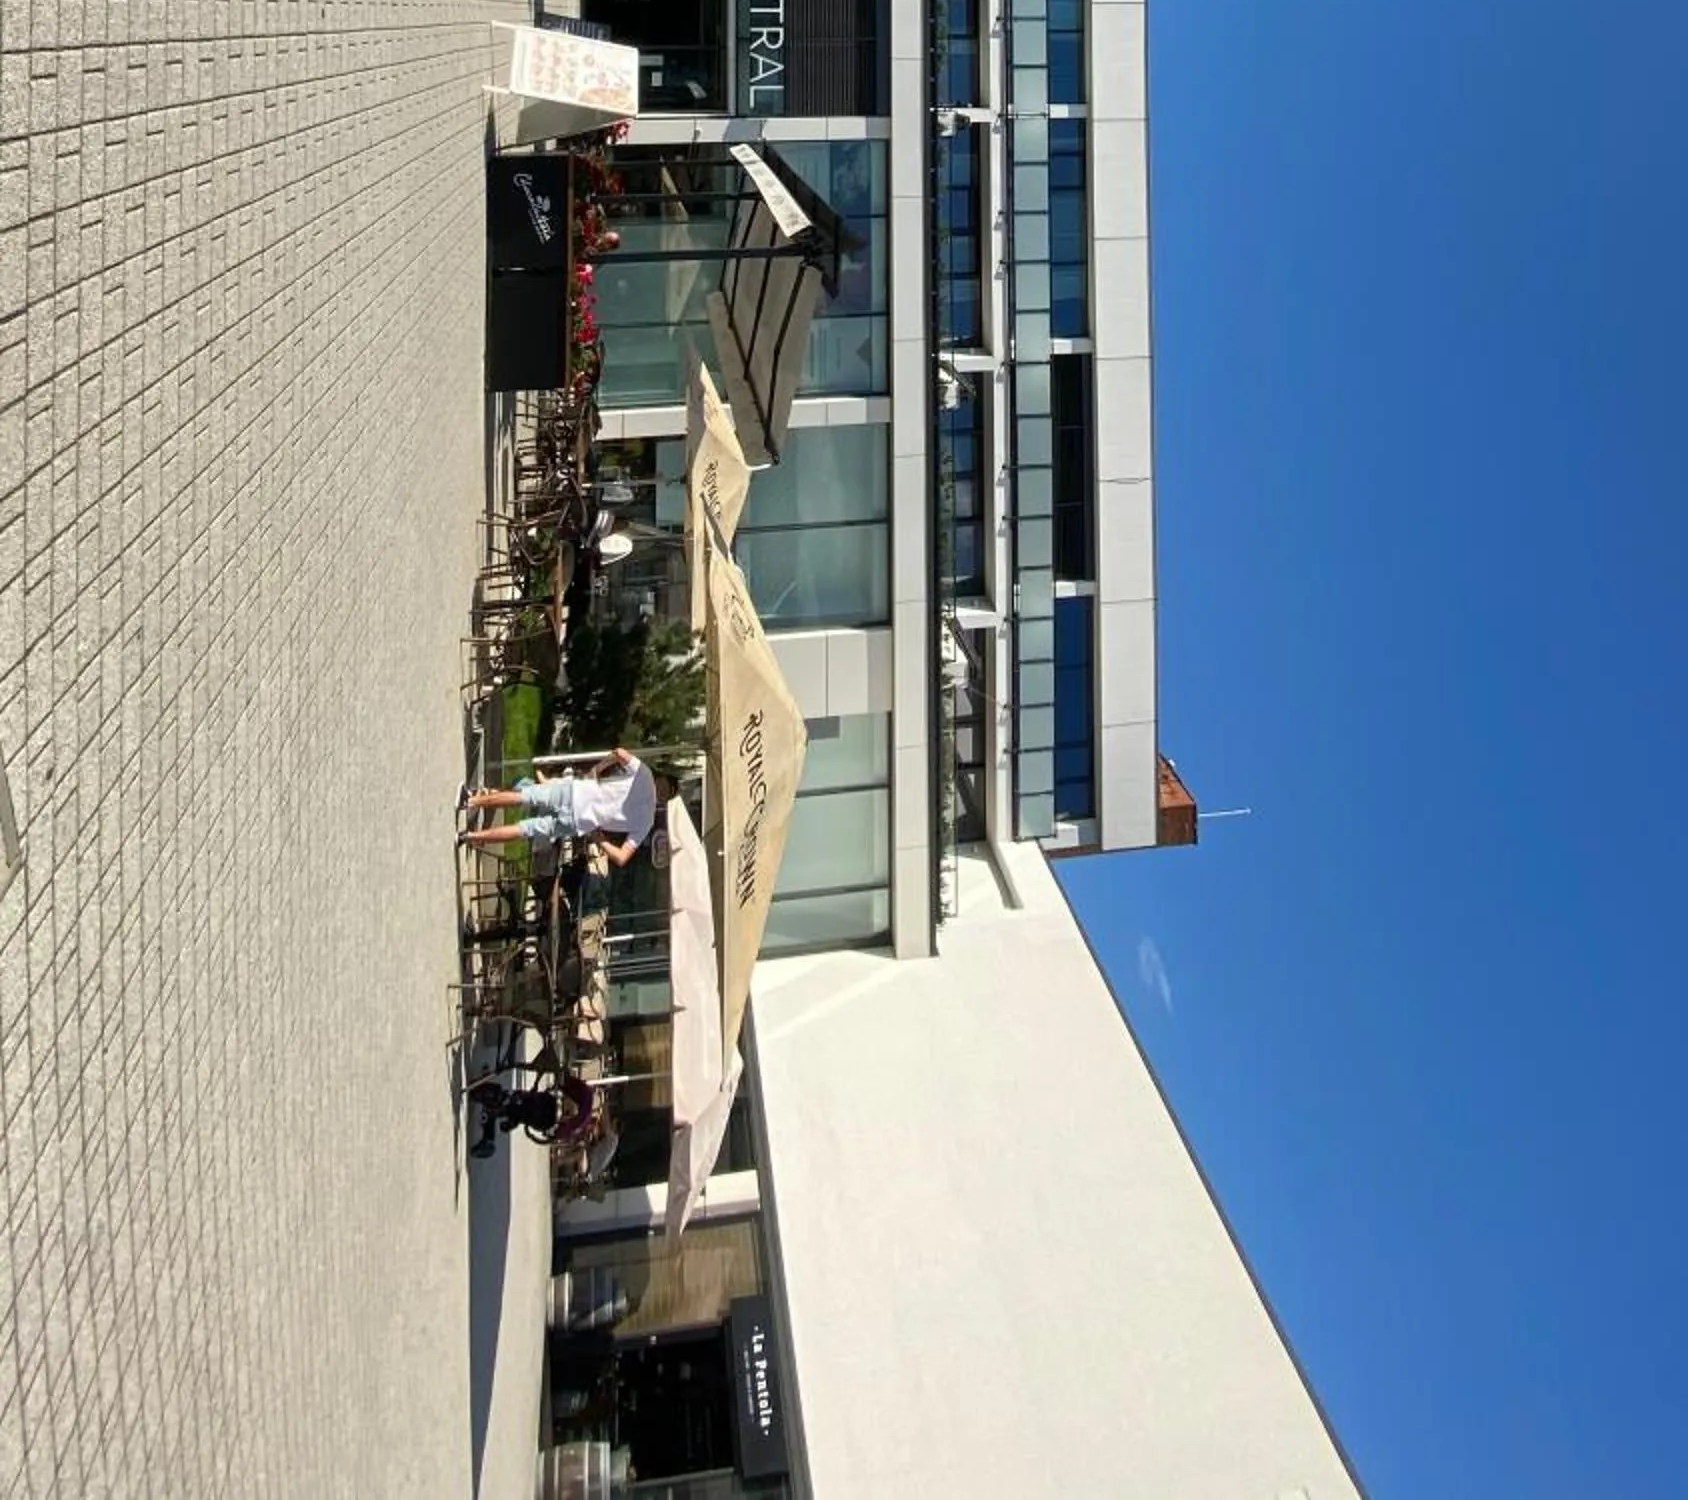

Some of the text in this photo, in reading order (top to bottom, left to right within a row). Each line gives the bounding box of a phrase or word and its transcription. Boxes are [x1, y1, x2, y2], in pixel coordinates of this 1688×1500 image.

[739, 709, 766, 803] ROYAL
[752, 1333, 773, 1428] La Pentola
